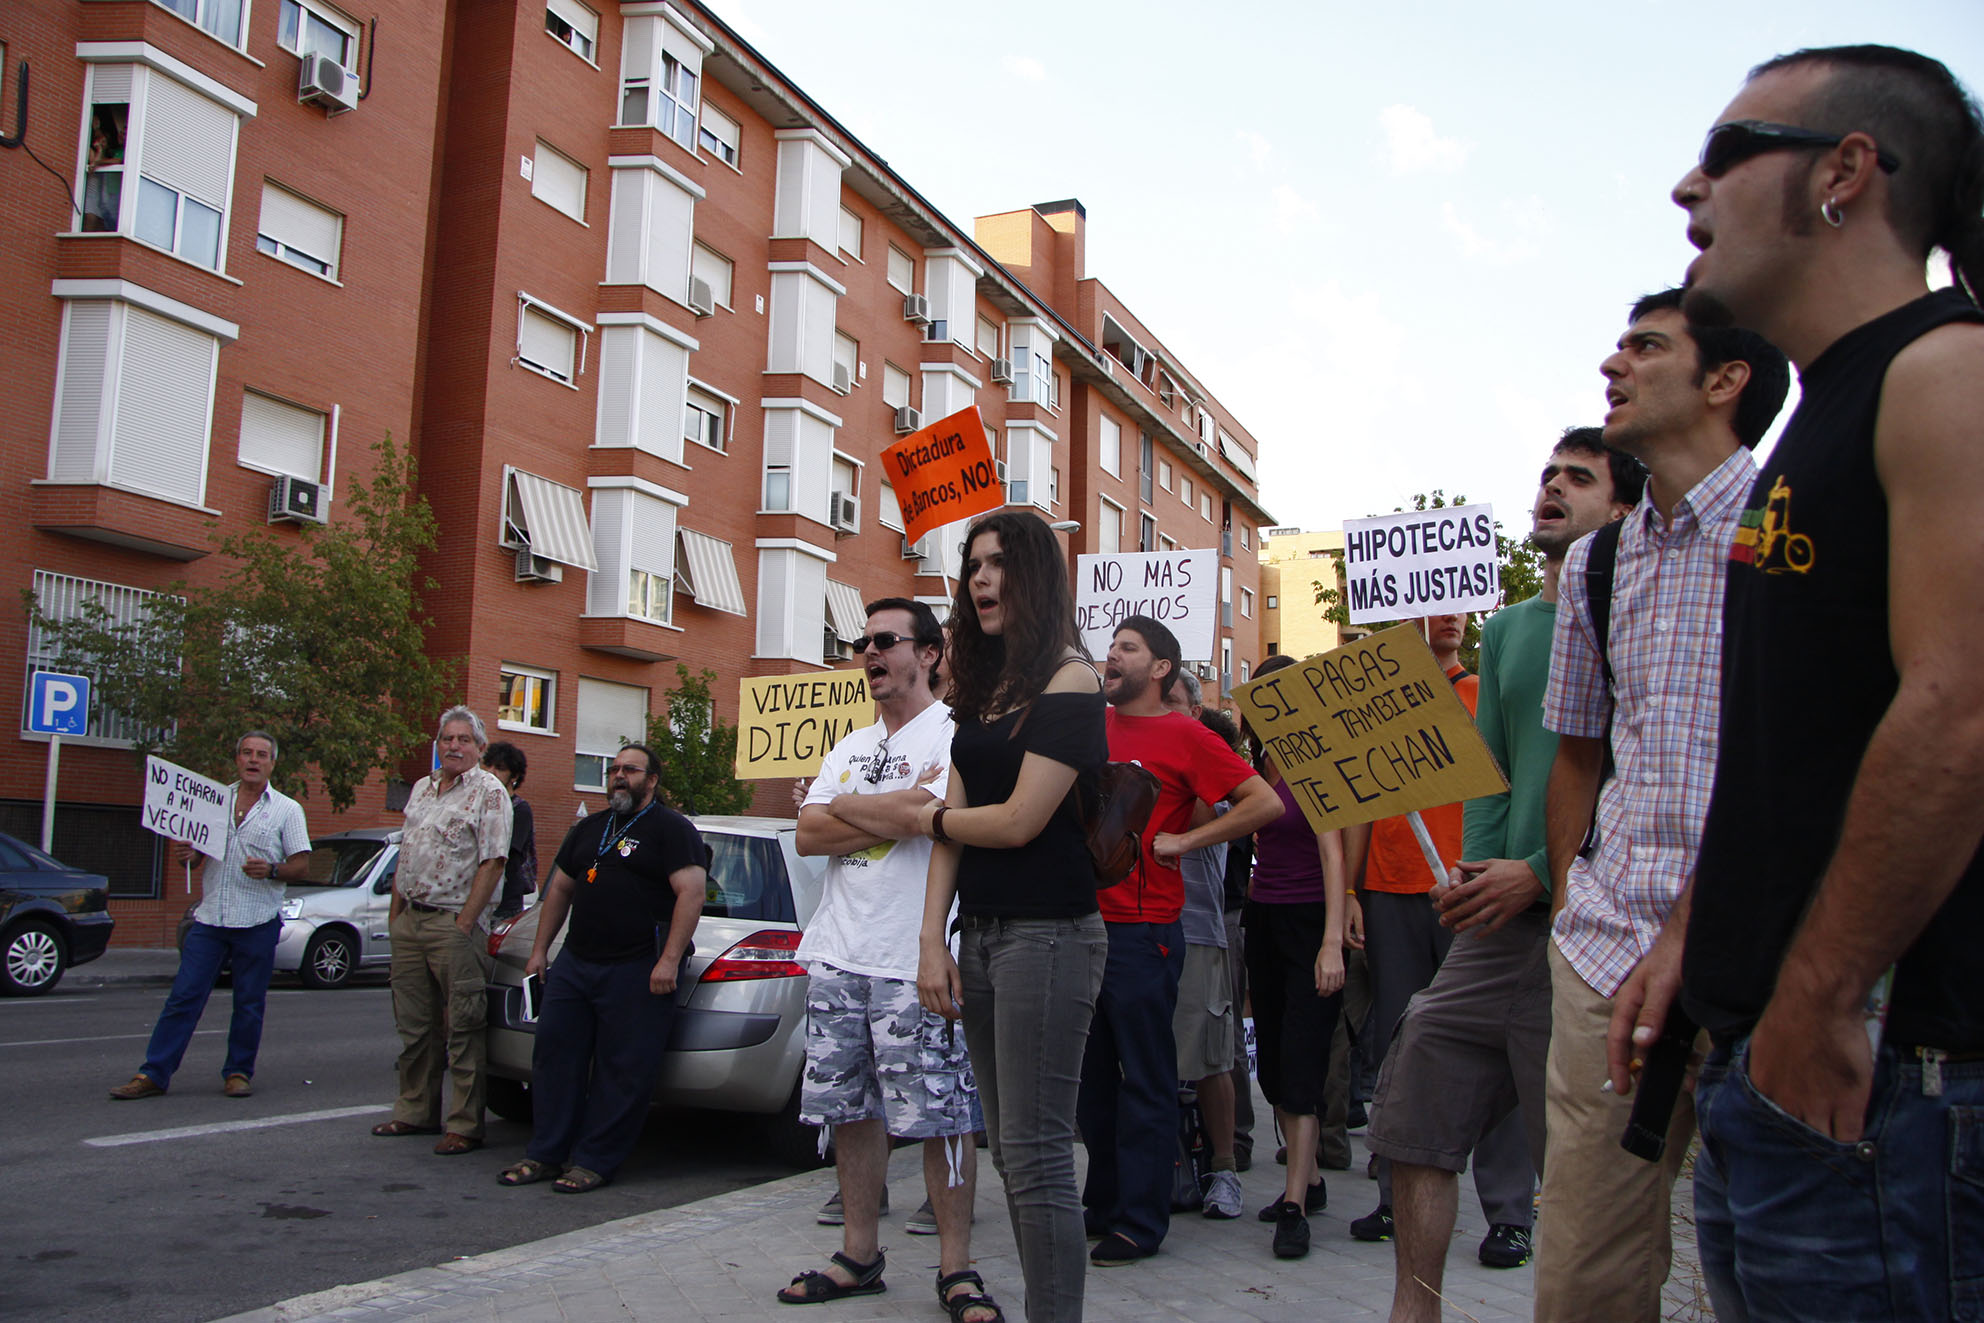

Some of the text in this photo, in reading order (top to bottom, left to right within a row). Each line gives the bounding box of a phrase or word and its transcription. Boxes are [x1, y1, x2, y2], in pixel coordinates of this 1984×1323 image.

[896, 433, 966, 477] Dictadura
[903, 458, 996, 524] de Bancos, NO!
[1347, 514, 1491, 563] HIPOTECAS
[1093, 558, 1192, 593] NO MAS
[1351, 562, 1494, 611] MÁS JUSTAS!
[1078, 594, 1189, 631] DESAUCIOS
[43, 680, 78, 727] P
[751, 678, 866, 715] VIVIENDA
[1250, 643, 1400, 722] SI PAGAS
[1265, 679, 1435, 770] TARDE TAMBIEN
[151, 764, 224, 806] NO ECHARAN
[1292, 725, 1455, 818] TE ECHAN
[147, 804, 209, 845] VECINA
[166, 791, 194, 813] A MI
